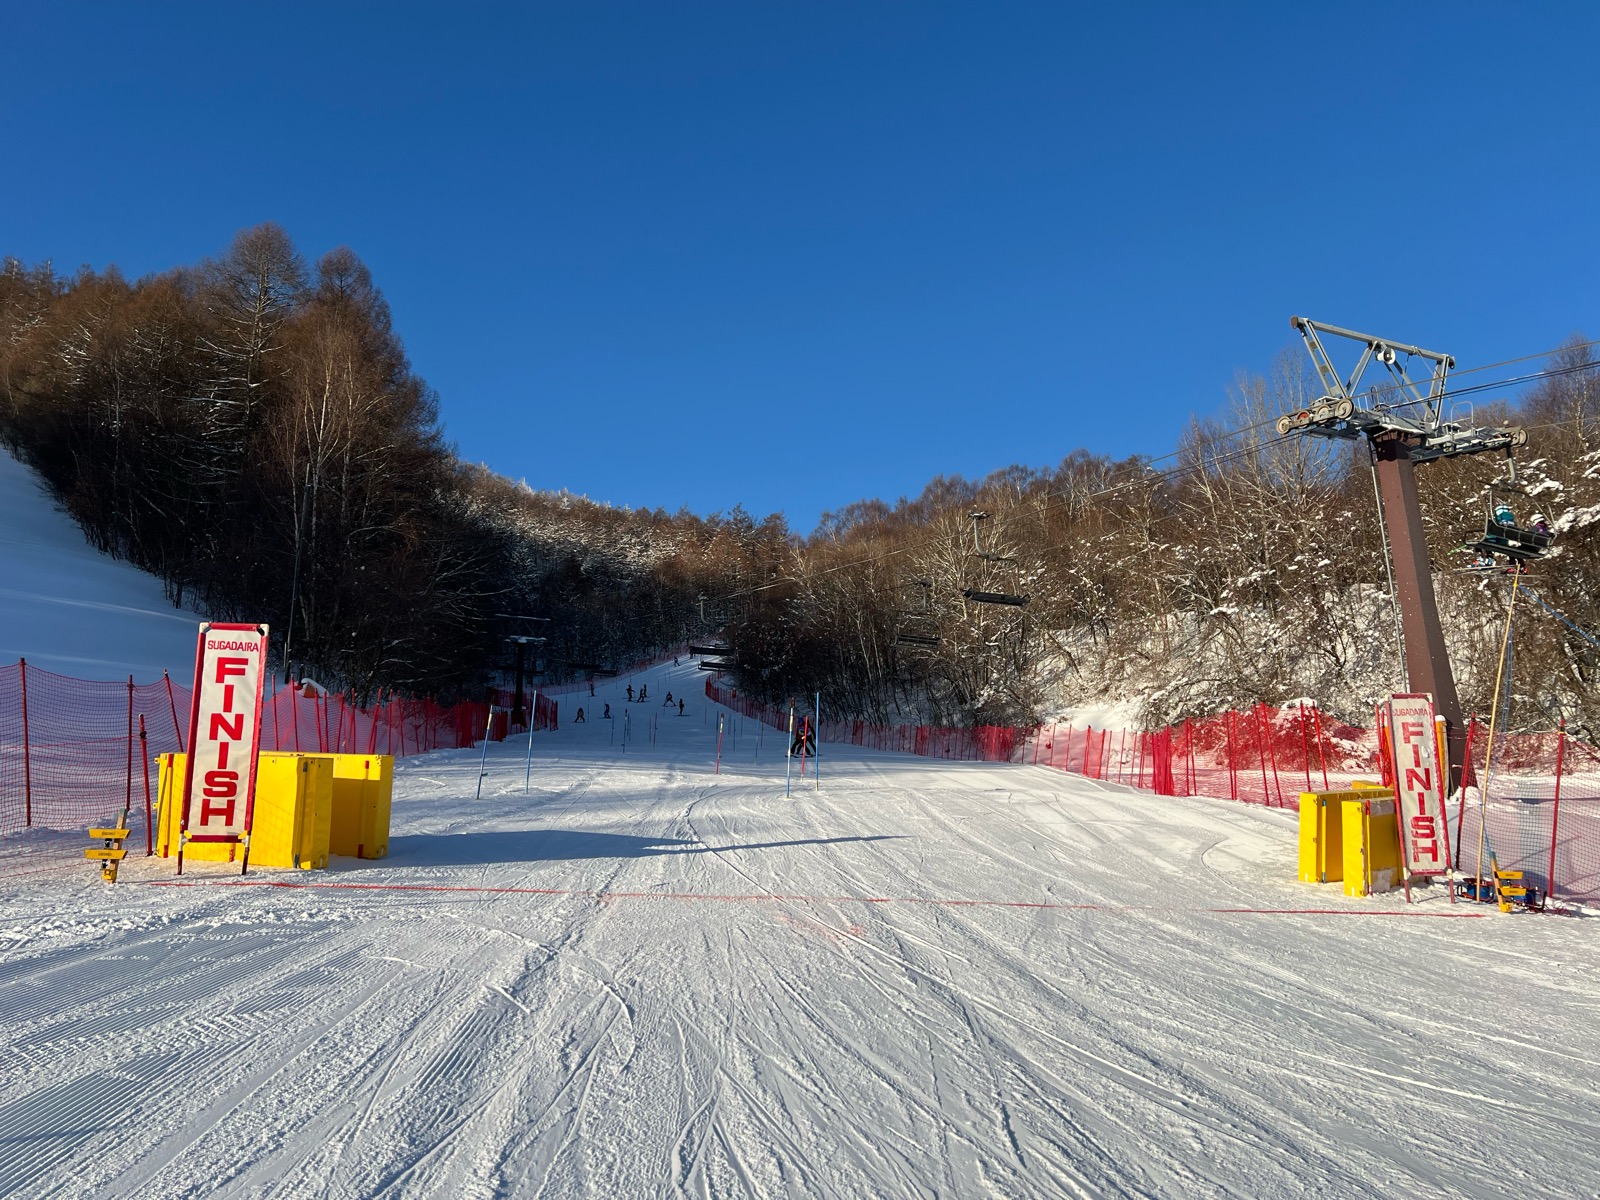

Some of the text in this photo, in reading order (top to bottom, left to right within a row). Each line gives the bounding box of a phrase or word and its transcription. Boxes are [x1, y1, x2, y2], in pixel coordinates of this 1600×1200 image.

[207, 640, 259, 652] SUGADAIRA
[200, 657, 249, 826] FINISH
[1401, 721, 1438, 862] FINISH
